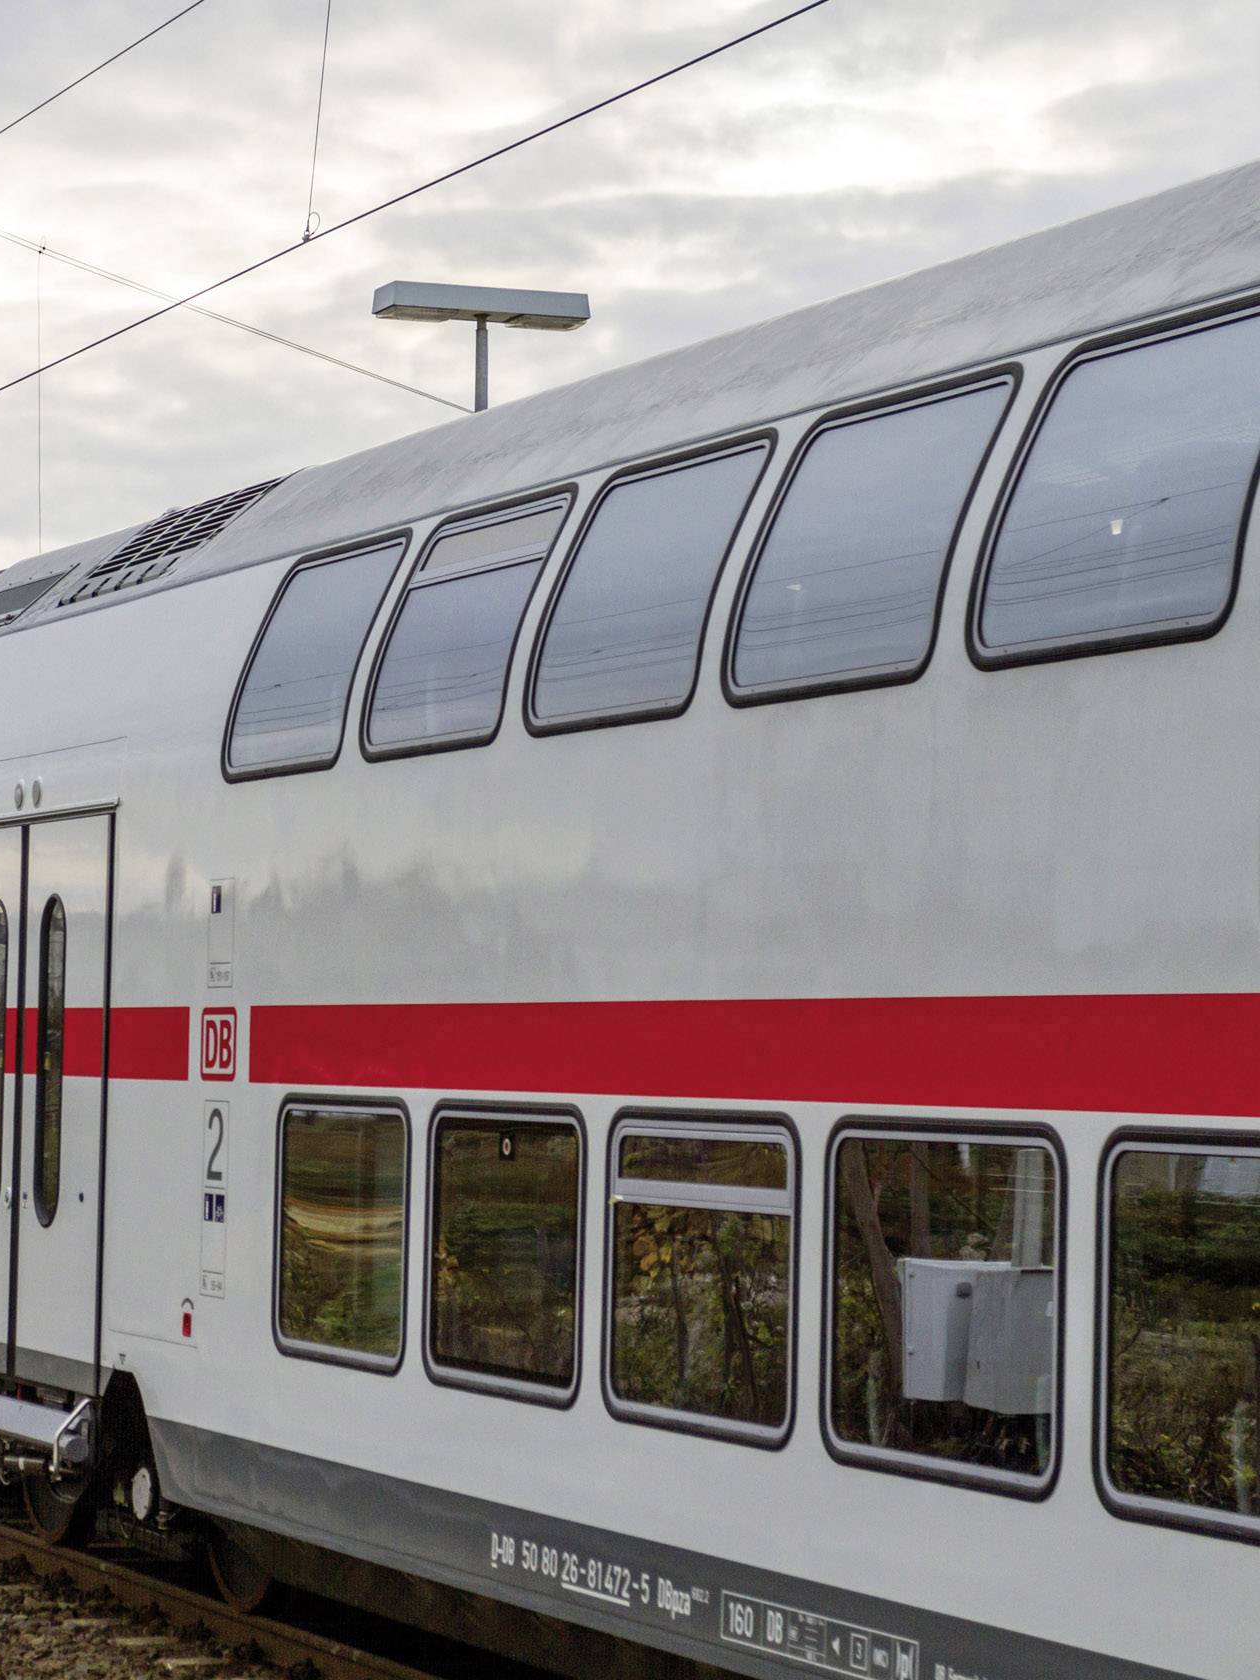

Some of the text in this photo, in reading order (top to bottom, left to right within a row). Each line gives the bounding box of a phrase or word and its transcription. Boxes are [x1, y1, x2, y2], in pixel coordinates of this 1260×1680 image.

[205, 1020, 232, 1069] DB
[206, 1108, 224, 1181] 2
[491, 1532, 516, 1567] D-DB
[521, 1540, 538, 1572] 50
[541, 1546, 558, 1578] 80
[728, 1602, 754, 1638] 160
[766, 1610, 783, 1644] DB
